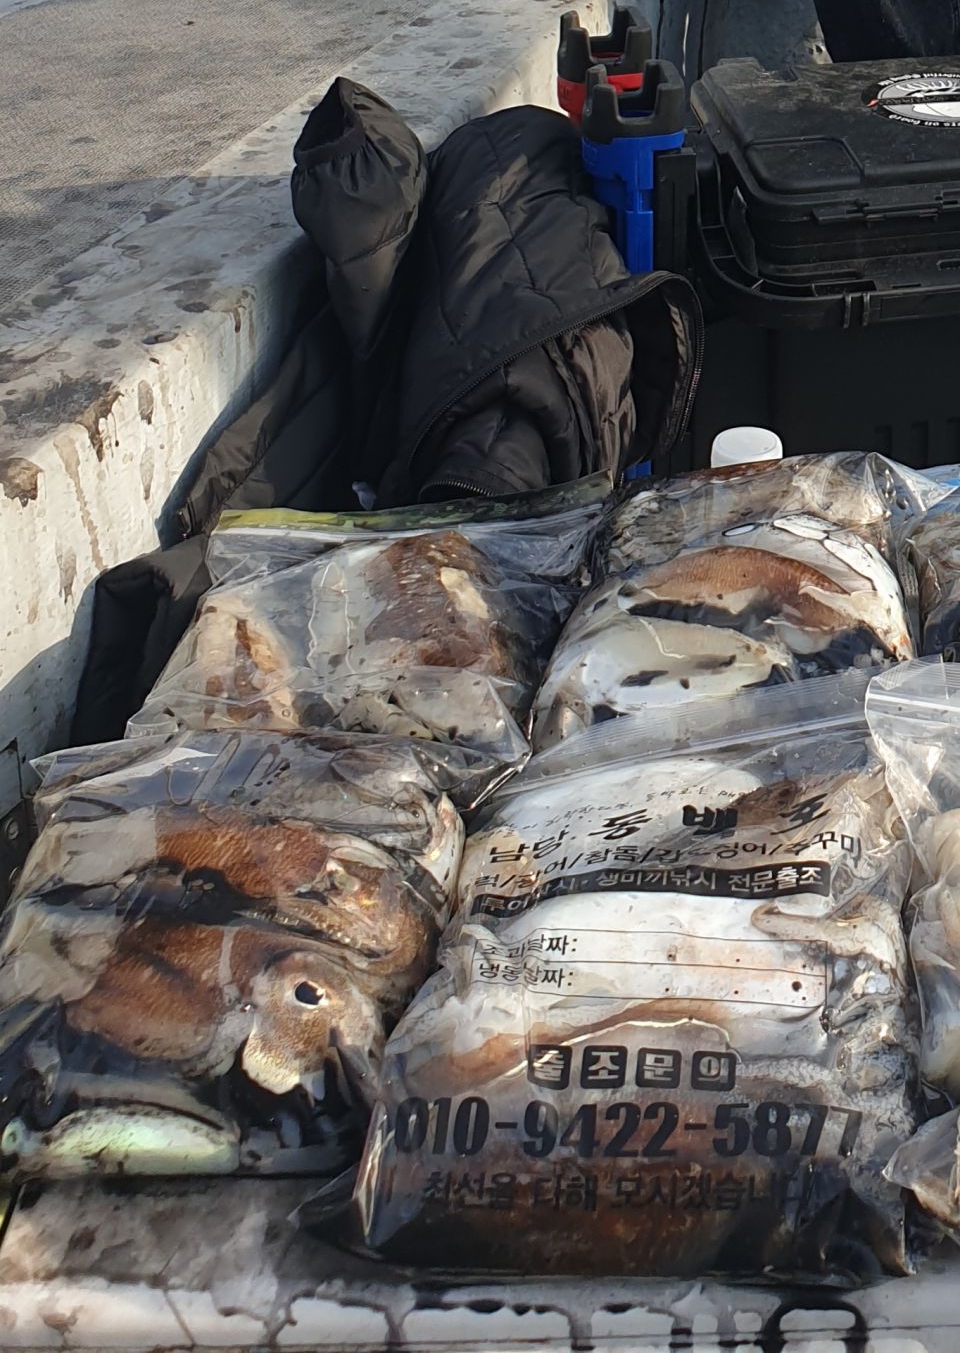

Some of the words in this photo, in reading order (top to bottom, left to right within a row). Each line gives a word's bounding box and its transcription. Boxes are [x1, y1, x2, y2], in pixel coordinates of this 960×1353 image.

[597, 868, 716, 892] 생미끼낚시
[727, 865, 824, 893] 전문출조
[395, 1096, 863, 1158] 010-9422-5877
